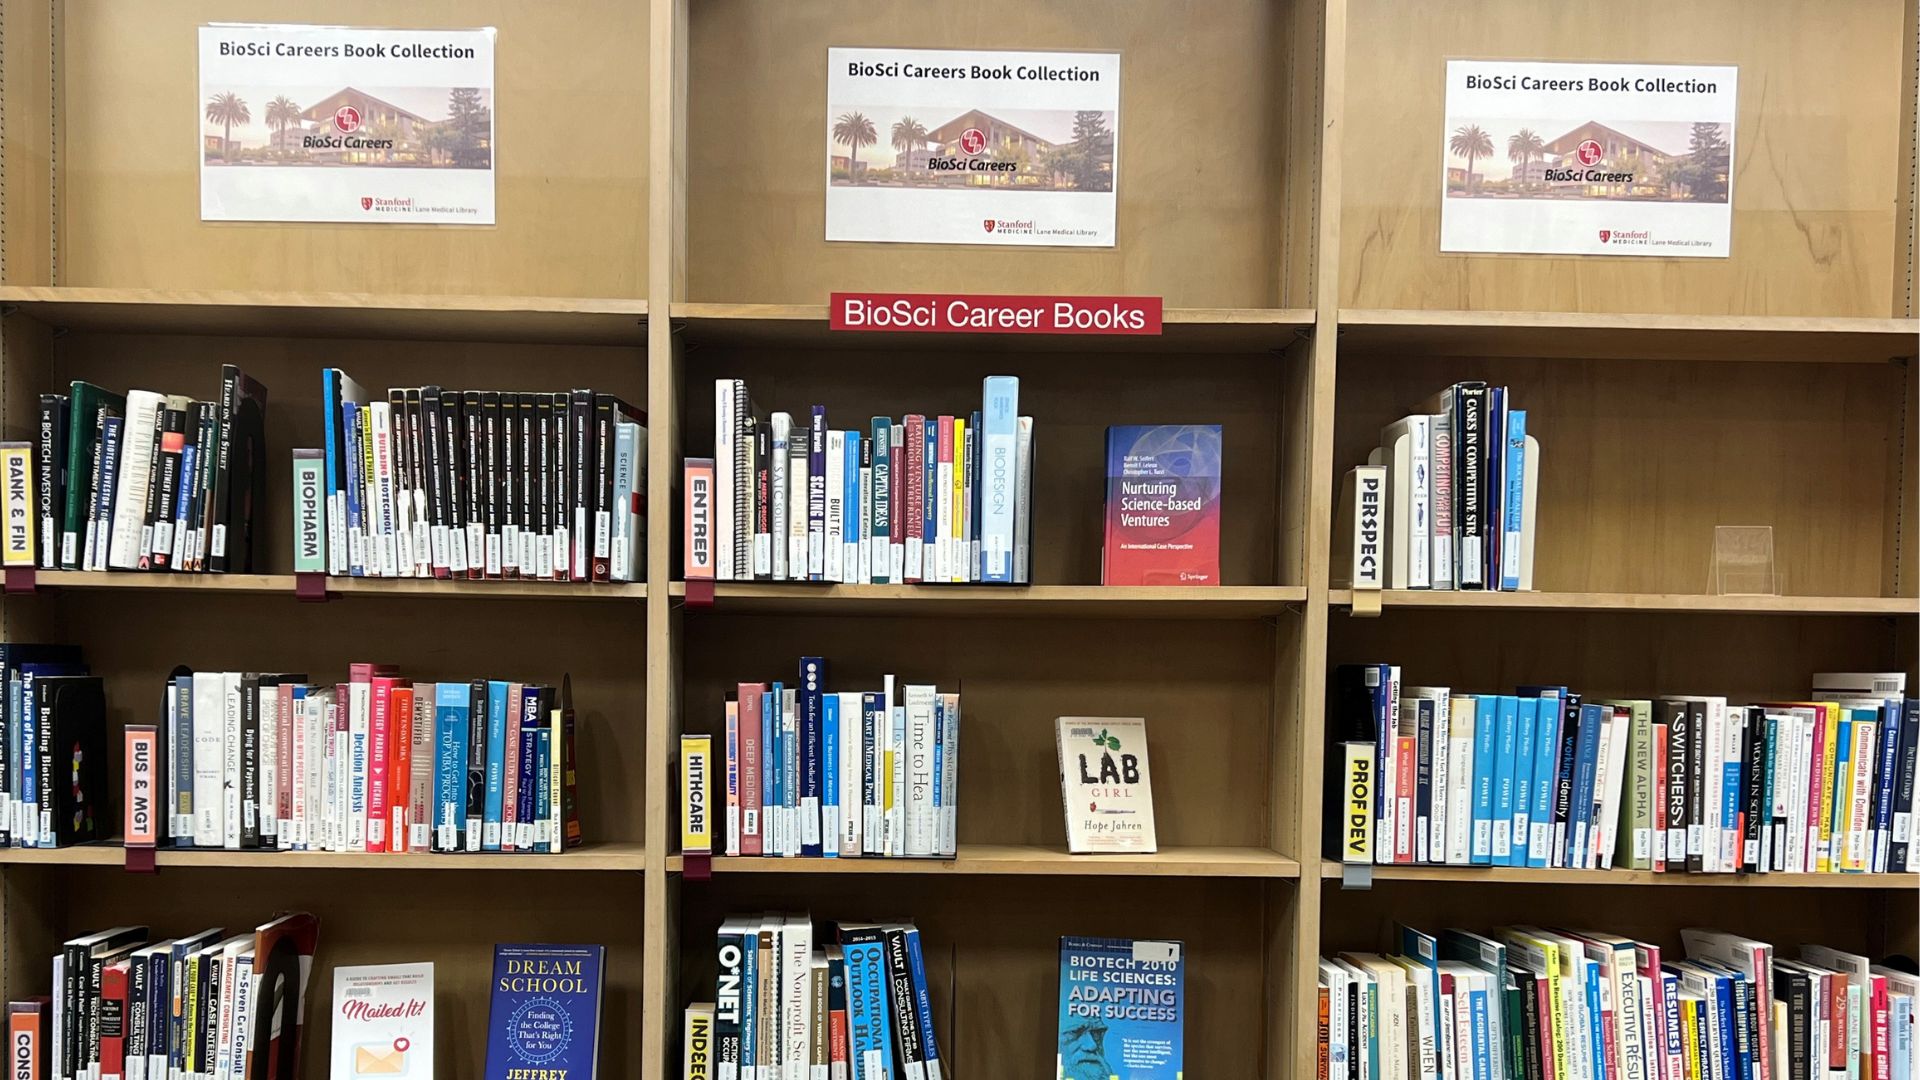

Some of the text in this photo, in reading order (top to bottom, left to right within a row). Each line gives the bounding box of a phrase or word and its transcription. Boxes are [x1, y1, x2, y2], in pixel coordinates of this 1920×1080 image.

[219, 42, 474, 59] BioSci Careers Book Collection
[848, 62, 1099, 81] BioSci Careers Book Collection
[1466, 75, 1717, 93] BioSci Careers Book Collection
[303, 136, 393, 149] BioSci Careers
[928, 158, 1016, 172] BioSci Careers
[1545, 169, 1633, 183] BioSci Careers
[375, 198, 411, 206] Stanford
[456, 207, 477, 215] Library
[997, 220, 1032, 228] Stanford
[1613, 231, 1648, 239] Stanford
[844, 299, 1146, 329] BioSci Career Books
[223, 379, 233, 406] HEARD
[220, 441, 229, 469] STREET
[378, 433, 387, 476] BUILDING
[1466, 399, 1477, 513] CASES IN COMPETITIVE
[10, 457, 24, 499] BANK
[40, 422, 52, 520] BIOTECH INVESTOR'S
[619, 453, 627, 489] SCIENCE
[992, 447, 1006, 515] BIODESIGN
[809, 476, 824, 532] SCALING UP
[874, 464, 888, 527] CAPITAL IDEAS
[1121, 497, 1201, 511] Science-based
[1122, 482, 1176, 496] Nurturing
[302, 471, 317, 557] BIOPHARM
[694, 480, 707, 565] ENTREP
[1121, 514, 1170, 527] Ventures
[1360, 478, 1378, 580] PERSPECT
[12, 526, 26, 551] FIN
[24, 672, 33, 770] The Future of Pharma
[375, 700, 385, 731] STRATEGY
[527, 696, 537, 721] MBA
[39, 707, 51, 752] Building
[181, 688, 189, 781] BRAVE LEADERSHIP
[227, 693, 235, 773] LEADING CHANGE
[245, 729, 254, 748] Dying
[913, 710, 930, 768] Time to
[135, 742, 148, 772] BUS
[374, 734, 383, 761] PARADOX
[524, 732, 533, 775] STRATEGY
[1856, 725, 1872, 796] Communicate with
[352, 733, 365, 813] Decision Analysis
[745, 739, 755, 811] DEEP MEDICINE
[1079, 752, 1139, 784] LAB
[1555, 736, 1574, 817] working identity
[1636, 711, 1647, 819] THE NEW ALPHA
[1671, 722, 1685, 816] SWITCHERS
[245, 767, 254, 799] Paycheck
[1092, 788, 1132, 798] GIRL
[1481, 777, 1489, 807] POWER
[1749, 741, 1762, 838] WOMEN IN SCIENCE
[134, 797, 148, 834] MGT
[1350, 759, 1369, 853] PROF DEV
[1085, 821, 1142, 832] Hope Jahren
[508, 960, 581, 975] DREAM
[1070, 956, 1177, 971] BIOTECH 2010
[1070, 970, 1176, 986] LIFE SCIENCES:
[221, 957, 233, 1044] MANAGEMENT CONSULTING
[238, 981, 248, 1012] Seven
[499, 978, 588, 993] SCHOOL
[790, 941, 806, 1035] The Nonprofit
[1069, 985, 1176, 1005] ADAPTING
[341, 999, 406, 1022] Mailed
[527, 1011, 555, 1020] Finding
[1068, 1003, 1176, 1021] FOR SUCCESS
[1621, 972, 1637, 1041] EXECUTIVE
[1666, 983, 1679, 1047] RESUMES
[518, 1031, 562, 1041] That's Right
[533, 1022, 561, 1031] College
[525, 1041, 552, 1050] for You
[1423, 1036, 1434, 1073] WHEN
[1876, 1010, 1888, 1079] the brand called
[506, 1069, 567, 1080] JEFFREY
